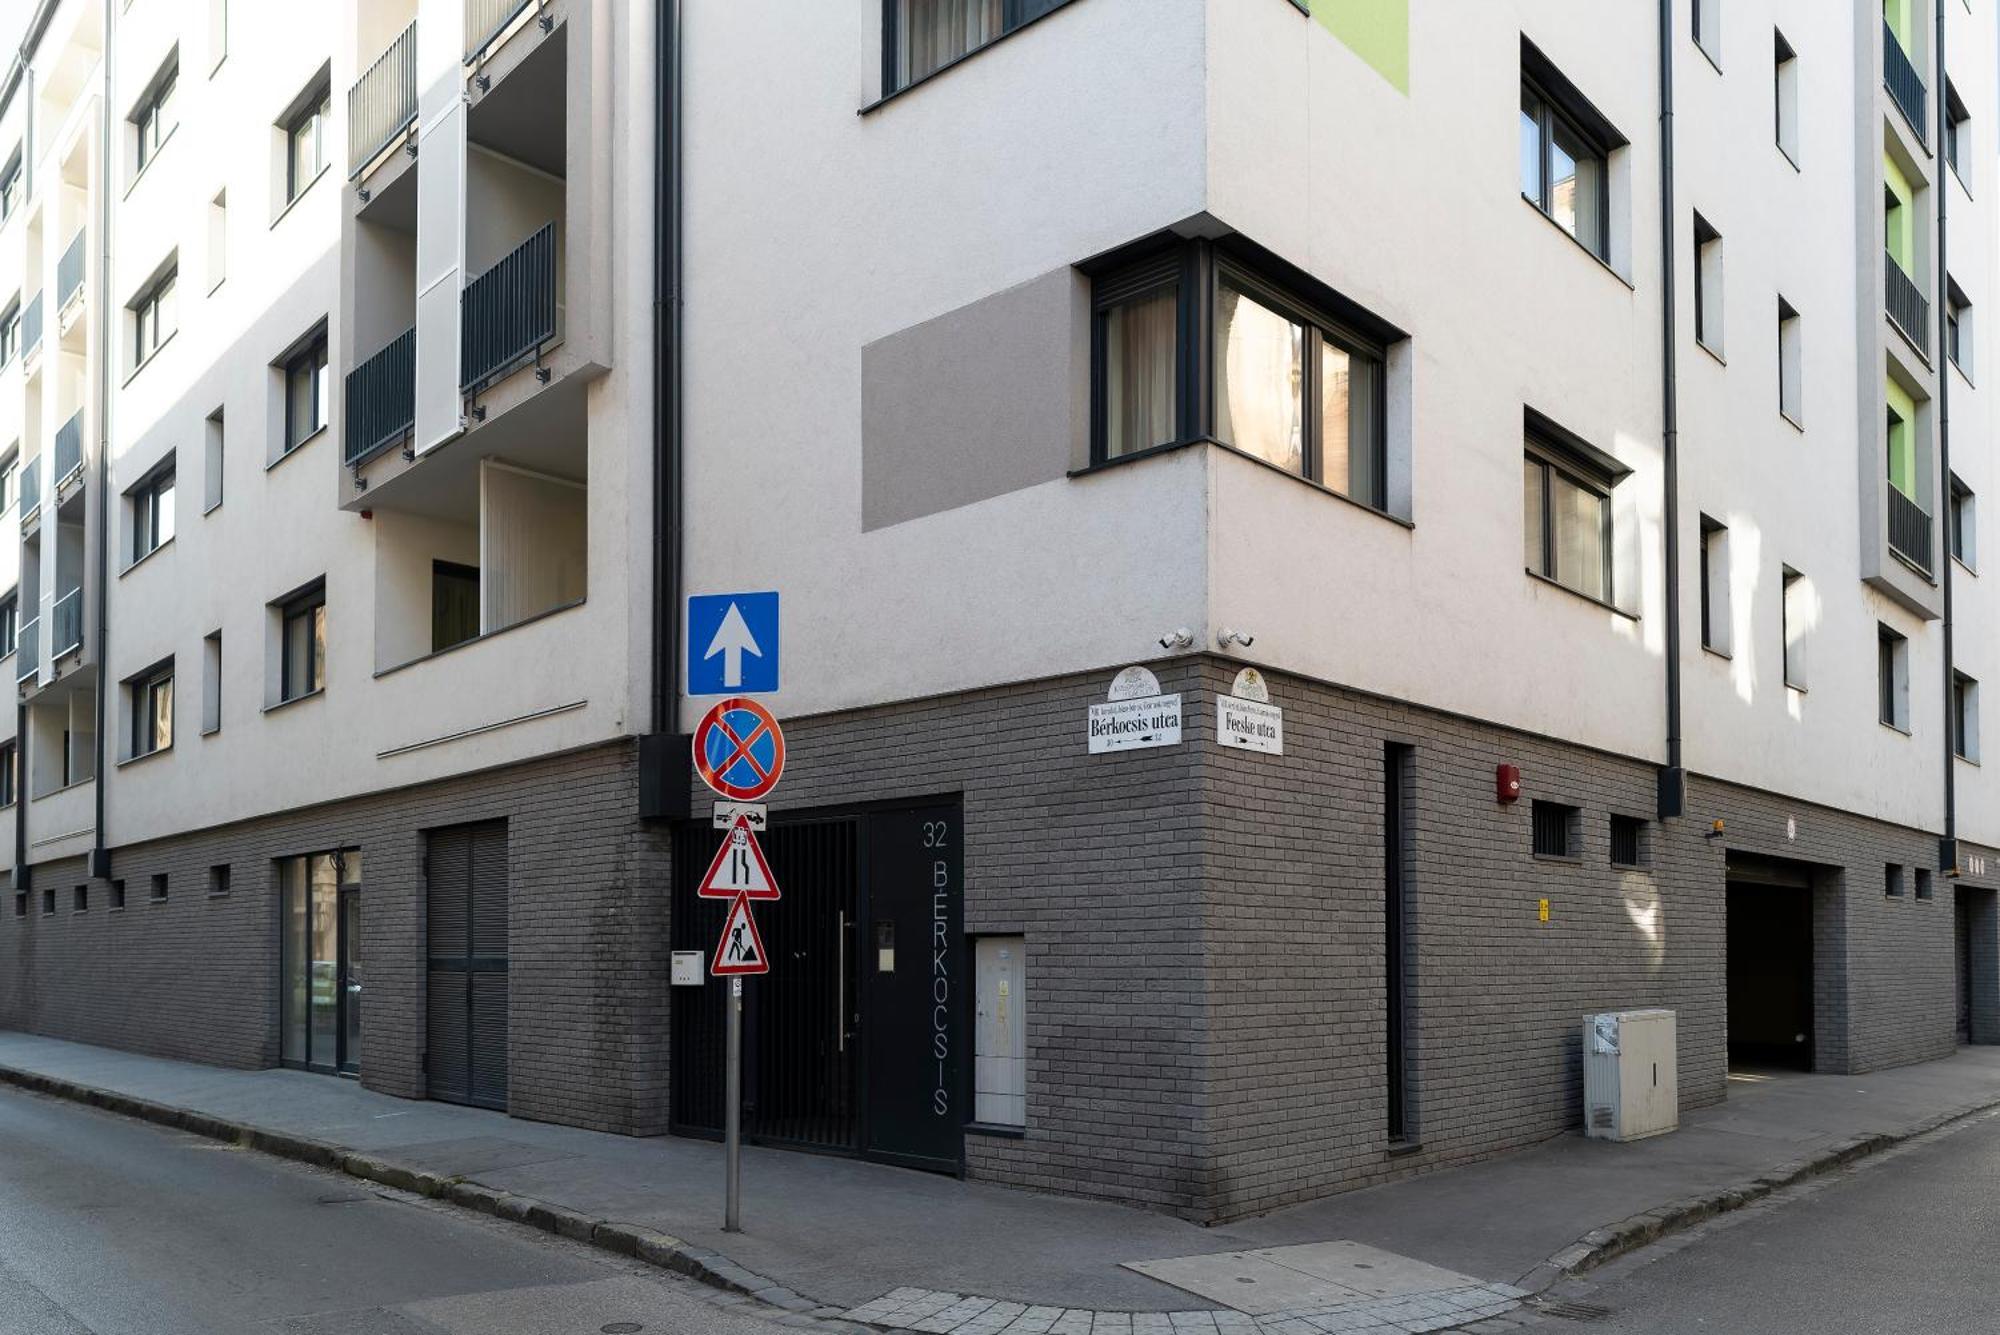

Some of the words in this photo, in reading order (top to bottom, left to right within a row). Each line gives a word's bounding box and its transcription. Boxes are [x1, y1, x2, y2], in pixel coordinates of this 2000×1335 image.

[1091, 713, 1149, 737] Bérkocsis
[1151, 712, 1179, 729] utca
[1226, 711, 1255, 735] Fecske
[1256, 721, 1276, 739] utca
[923, 821, 948, 847] 32
